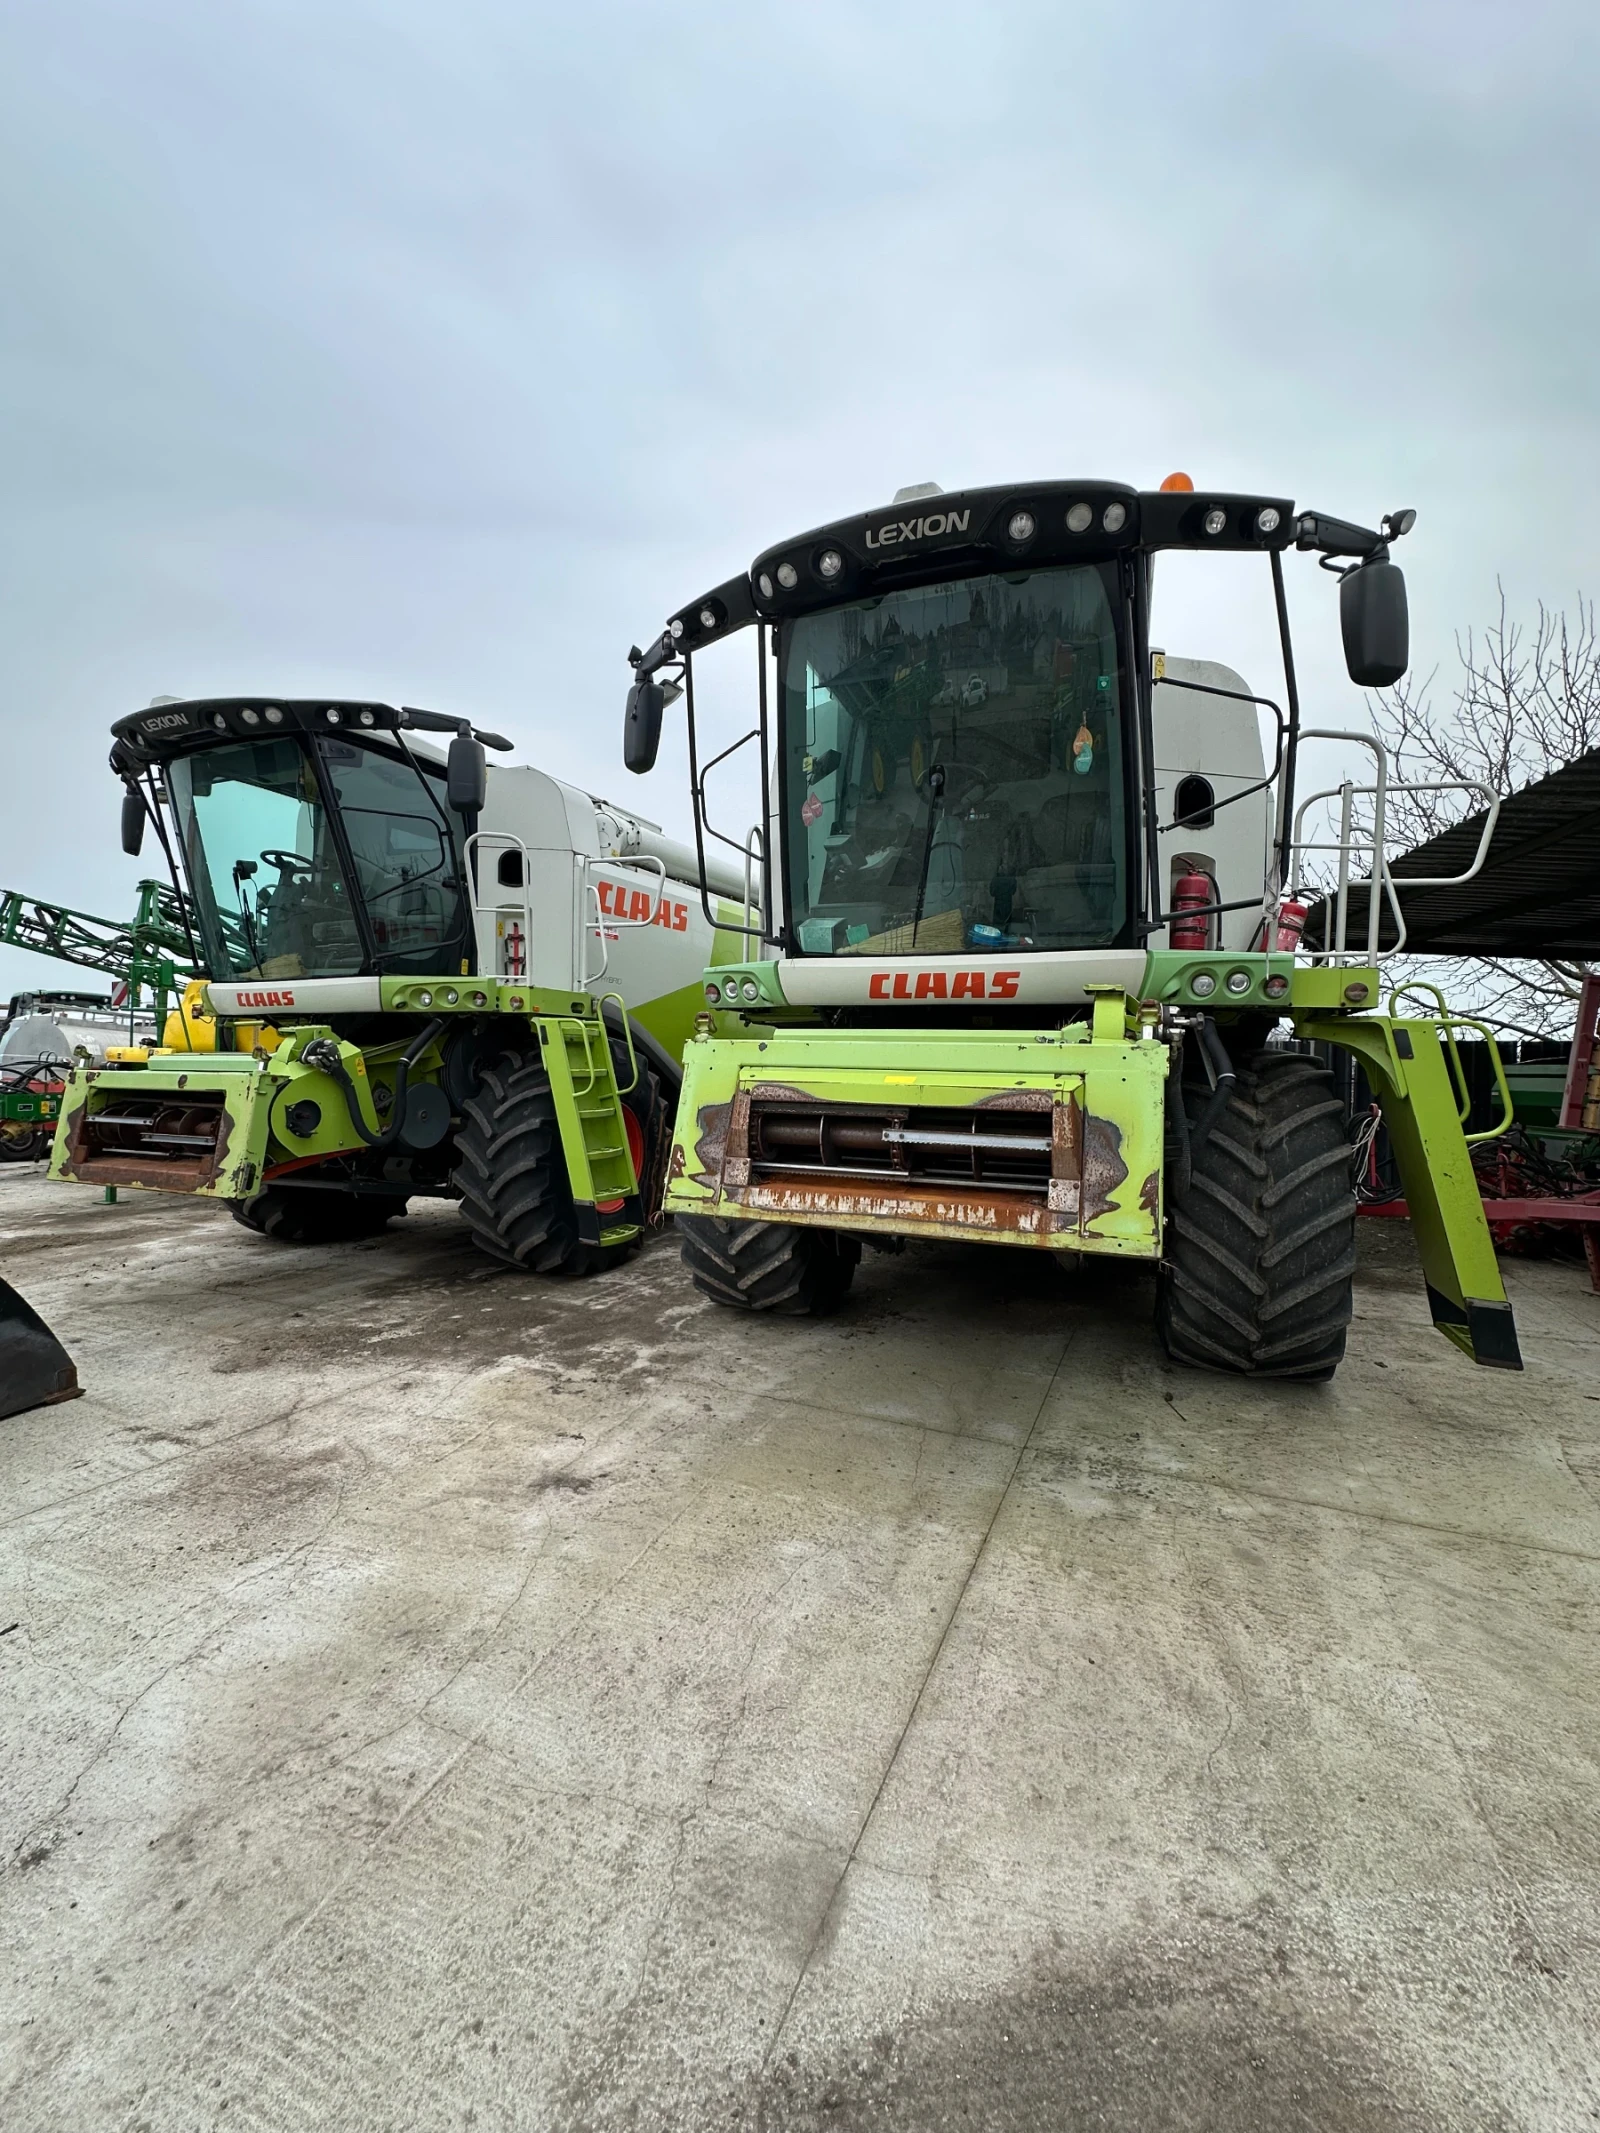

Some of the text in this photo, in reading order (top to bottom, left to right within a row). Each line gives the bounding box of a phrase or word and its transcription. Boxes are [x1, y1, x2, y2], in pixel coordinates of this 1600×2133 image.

[865, 509, 971, 549] LEXION
[141, 713, 189, 732] LEXION
[869, 971, 1020, 999] CLAAS
[236, 991, 295, 1007] CLAAS
